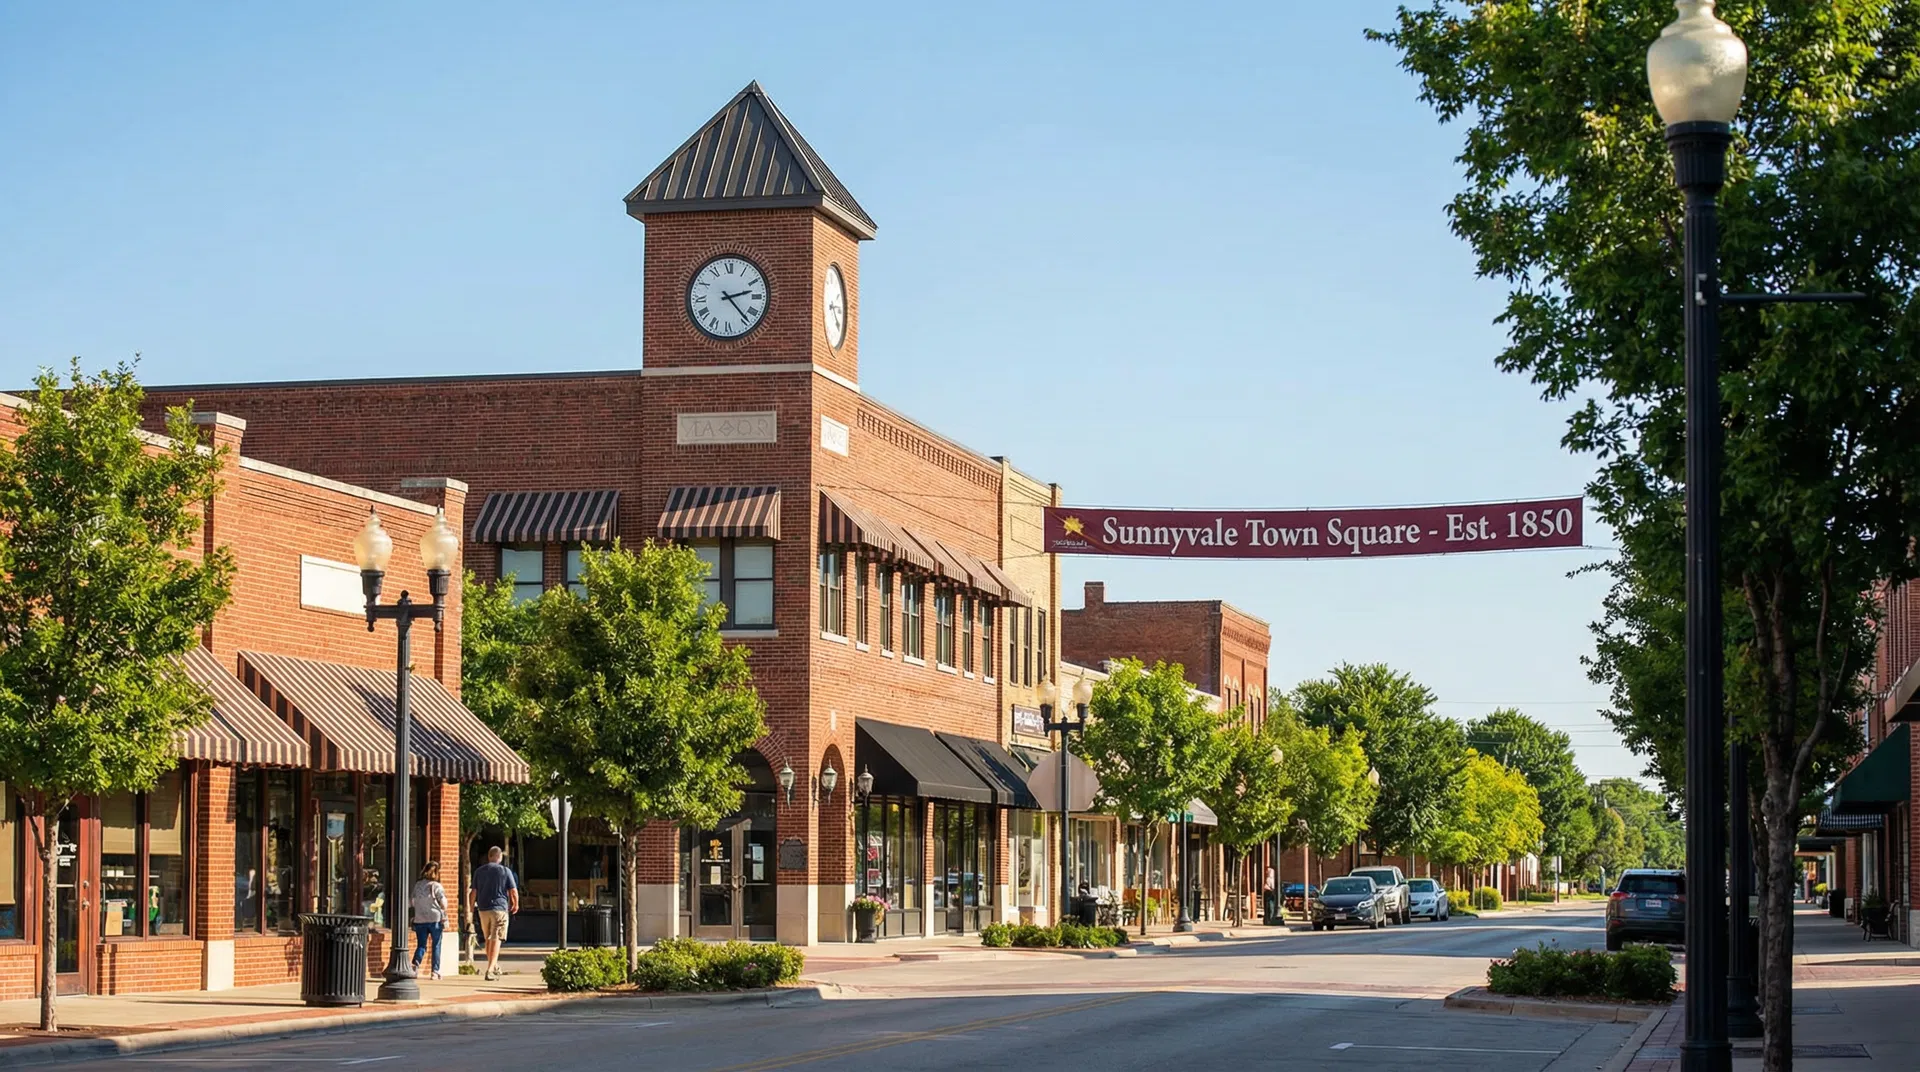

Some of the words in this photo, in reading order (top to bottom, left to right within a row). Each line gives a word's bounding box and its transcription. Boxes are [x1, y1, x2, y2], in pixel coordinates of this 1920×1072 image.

[1102, 516, 1239, 555] Sunnyvale
[1244, 519, 1320, 546] Town
[1326, 517, 1421, 555] Square
[1445, 513, 1497, 542] Est.
[1507, 508, 1573, 538] 1850
